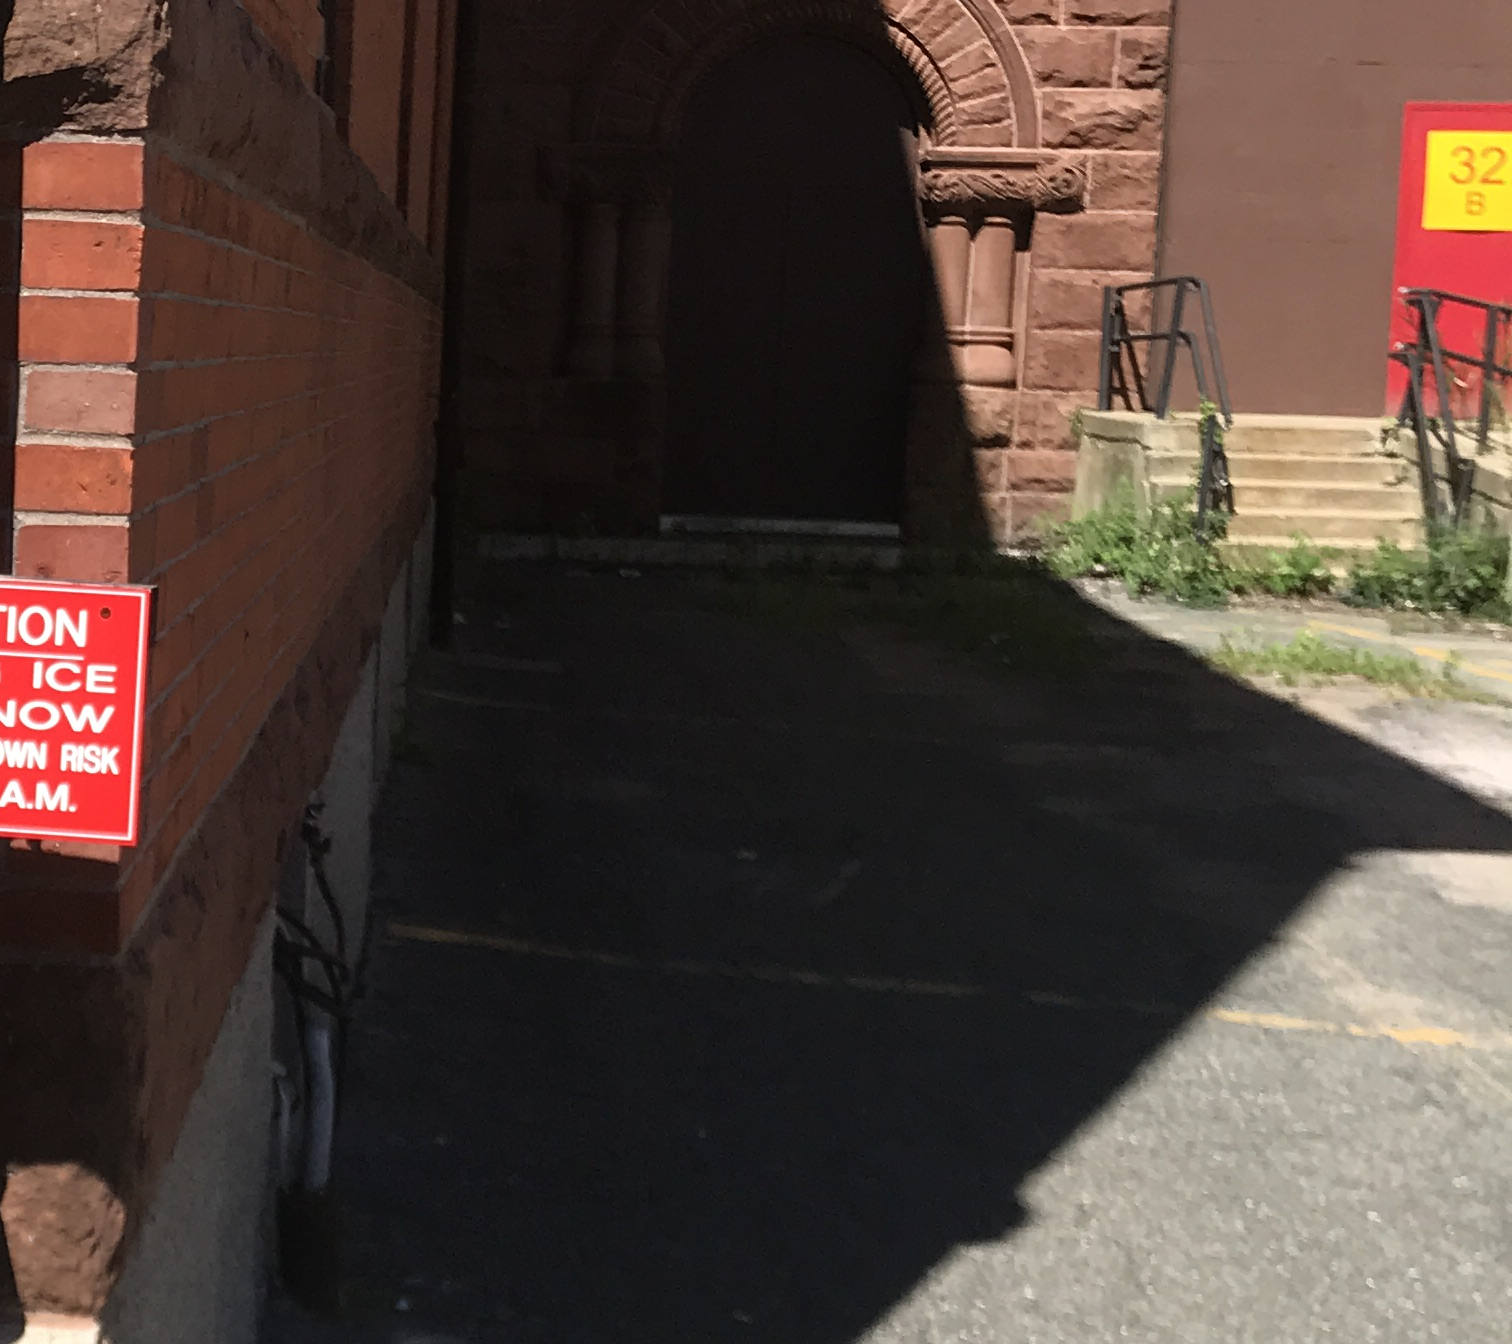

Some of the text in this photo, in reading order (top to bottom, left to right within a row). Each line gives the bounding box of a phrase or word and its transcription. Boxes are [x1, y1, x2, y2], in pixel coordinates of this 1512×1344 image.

[1449, 146, 1507, 185] 32
[33, 661, 117, 694] ICE
[61, 744, 119, 775] RISK
